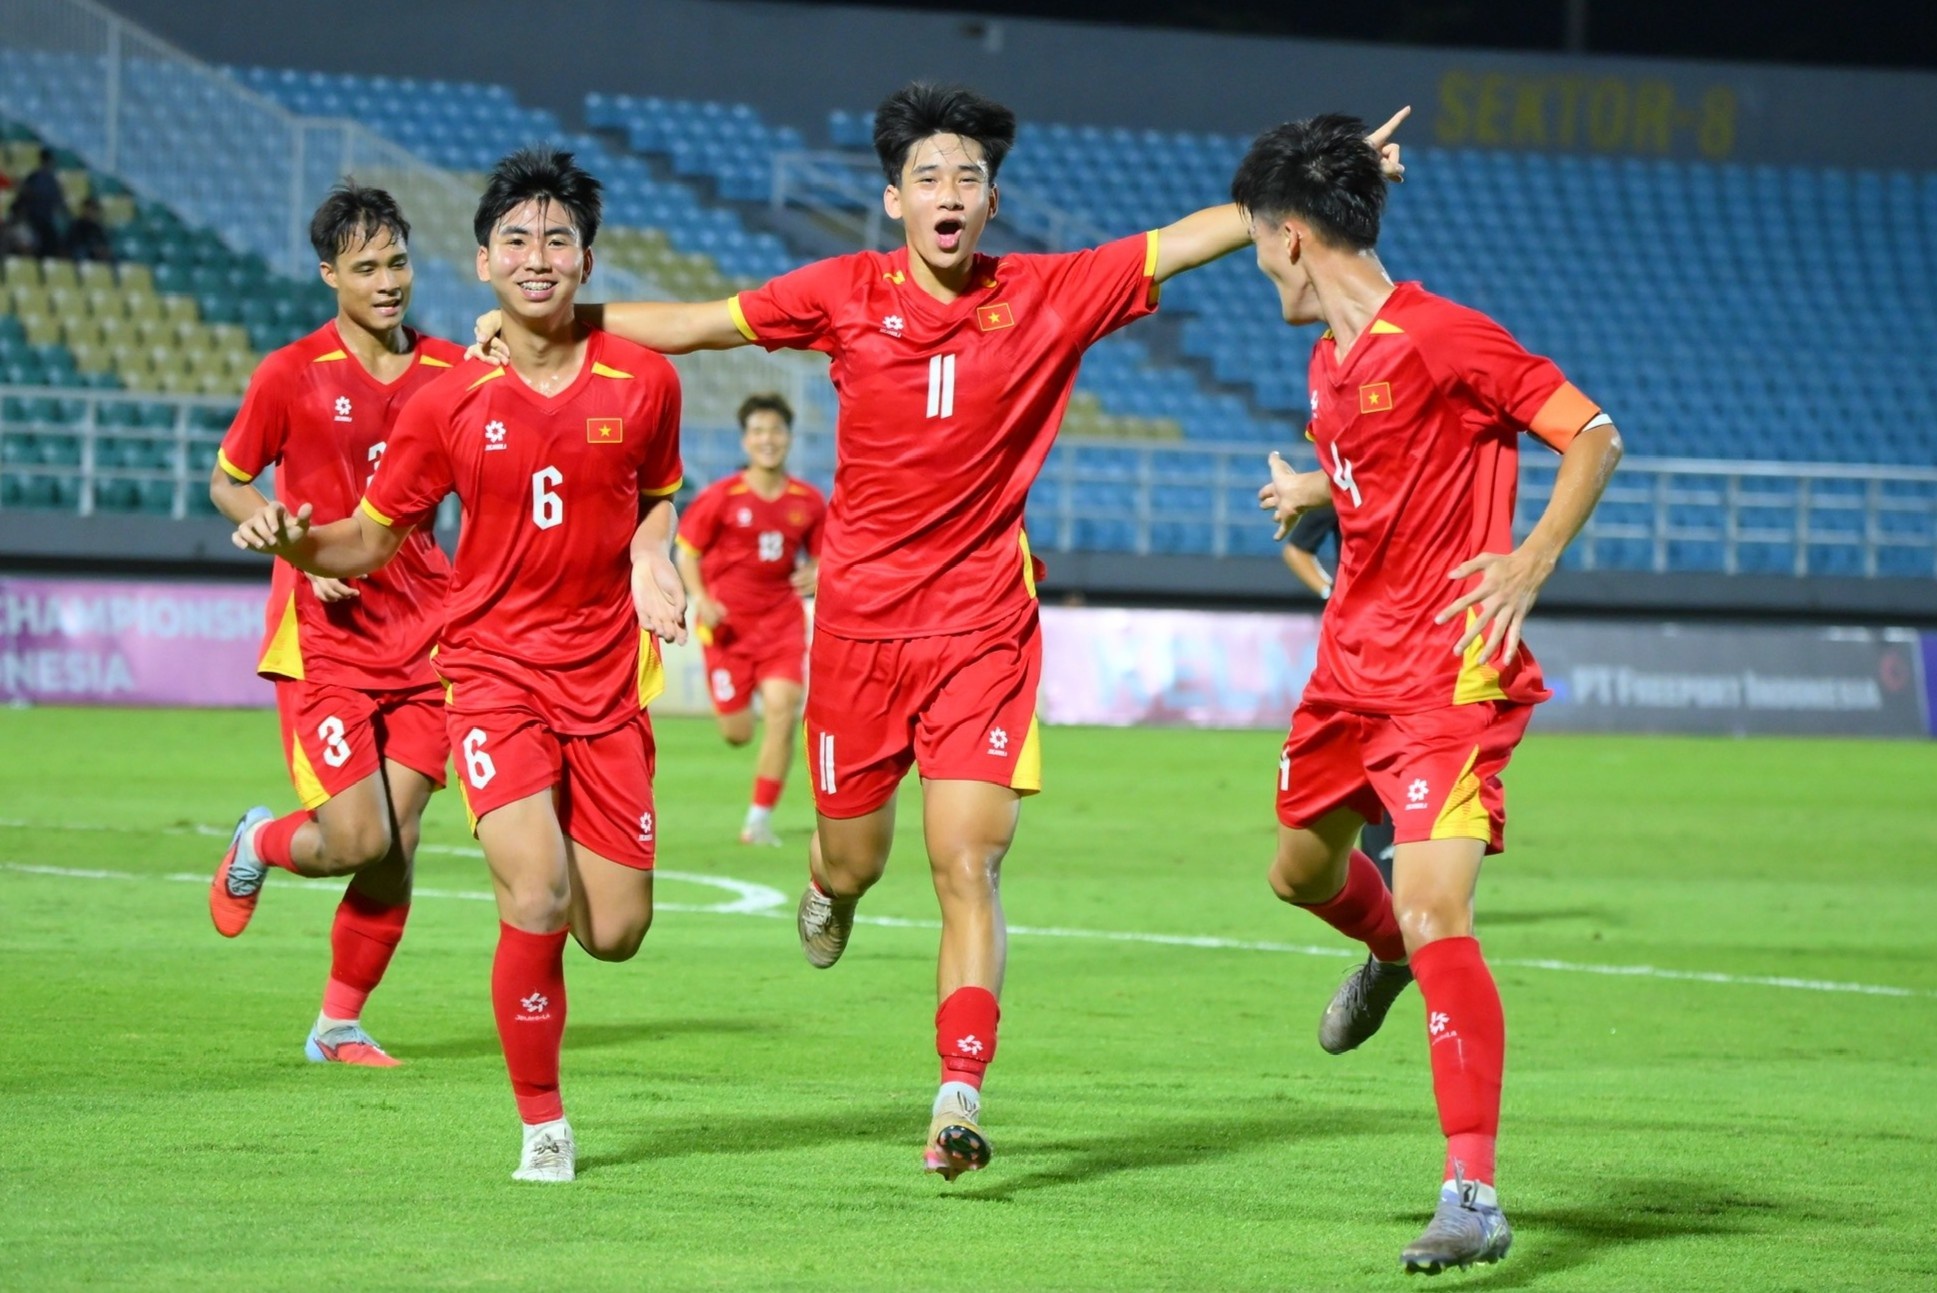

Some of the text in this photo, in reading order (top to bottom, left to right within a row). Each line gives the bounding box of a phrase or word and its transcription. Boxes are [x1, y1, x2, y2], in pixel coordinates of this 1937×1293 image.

[1435, 69, 1737, 157] SEKTOR-8
[926, 354, 955, 419] 11
[532, 465, 563, 530] 6
[1330, 441, 1362, 508] 4
[0, 596, 265, 640] HAMPIONSH
[318, 715, 352, 768] 3
[463, 727, 496, 790] 6
[820, 732, 837, 794] 11
